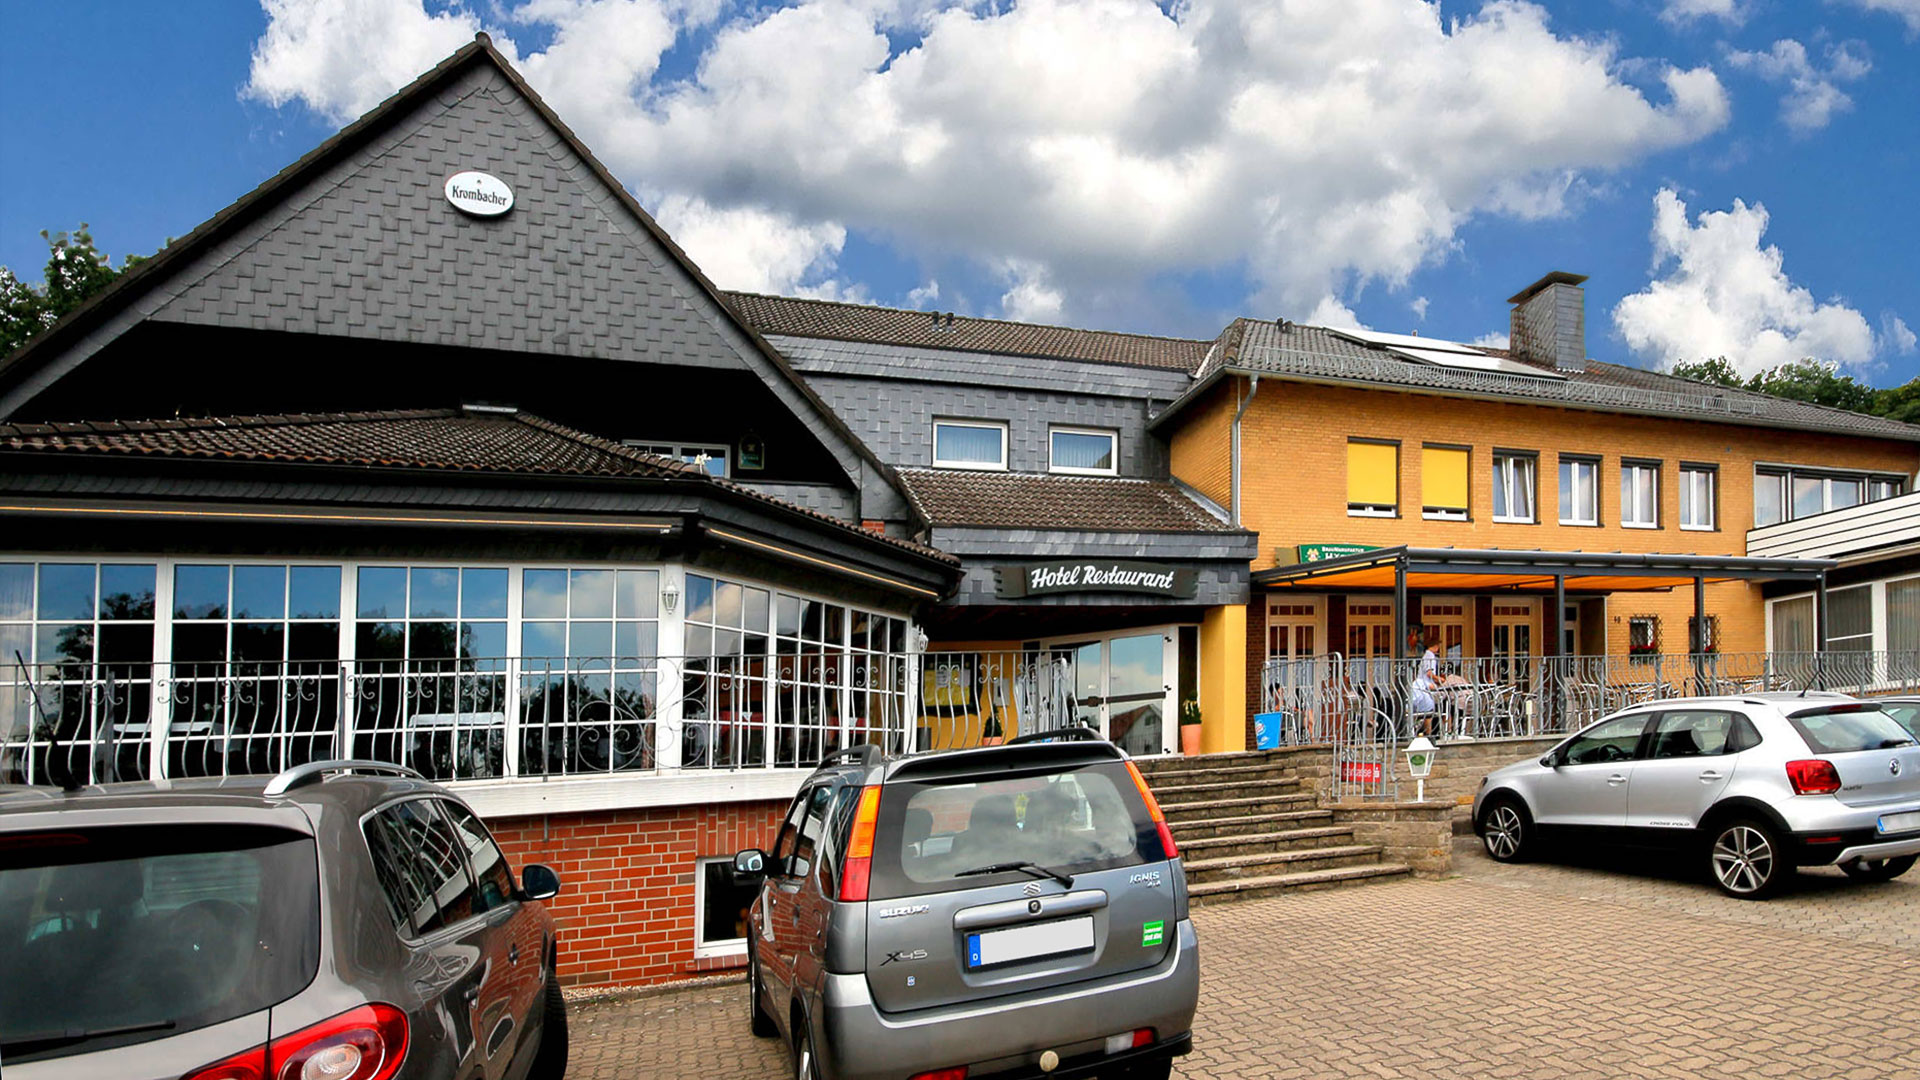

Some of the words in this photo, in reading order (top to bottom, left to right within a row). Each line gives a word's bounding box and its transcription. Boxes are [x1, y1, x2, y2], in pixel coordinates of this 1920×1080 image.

[452, 185, 508, 207] Krombacher
[1031, 566, 1081, 588] Hotel
[1082, 565, 1174, 589] Restaurant
[1129, 871, 1160, 884] IGNIS
[880, 904, 930, 918] SUZUKI
